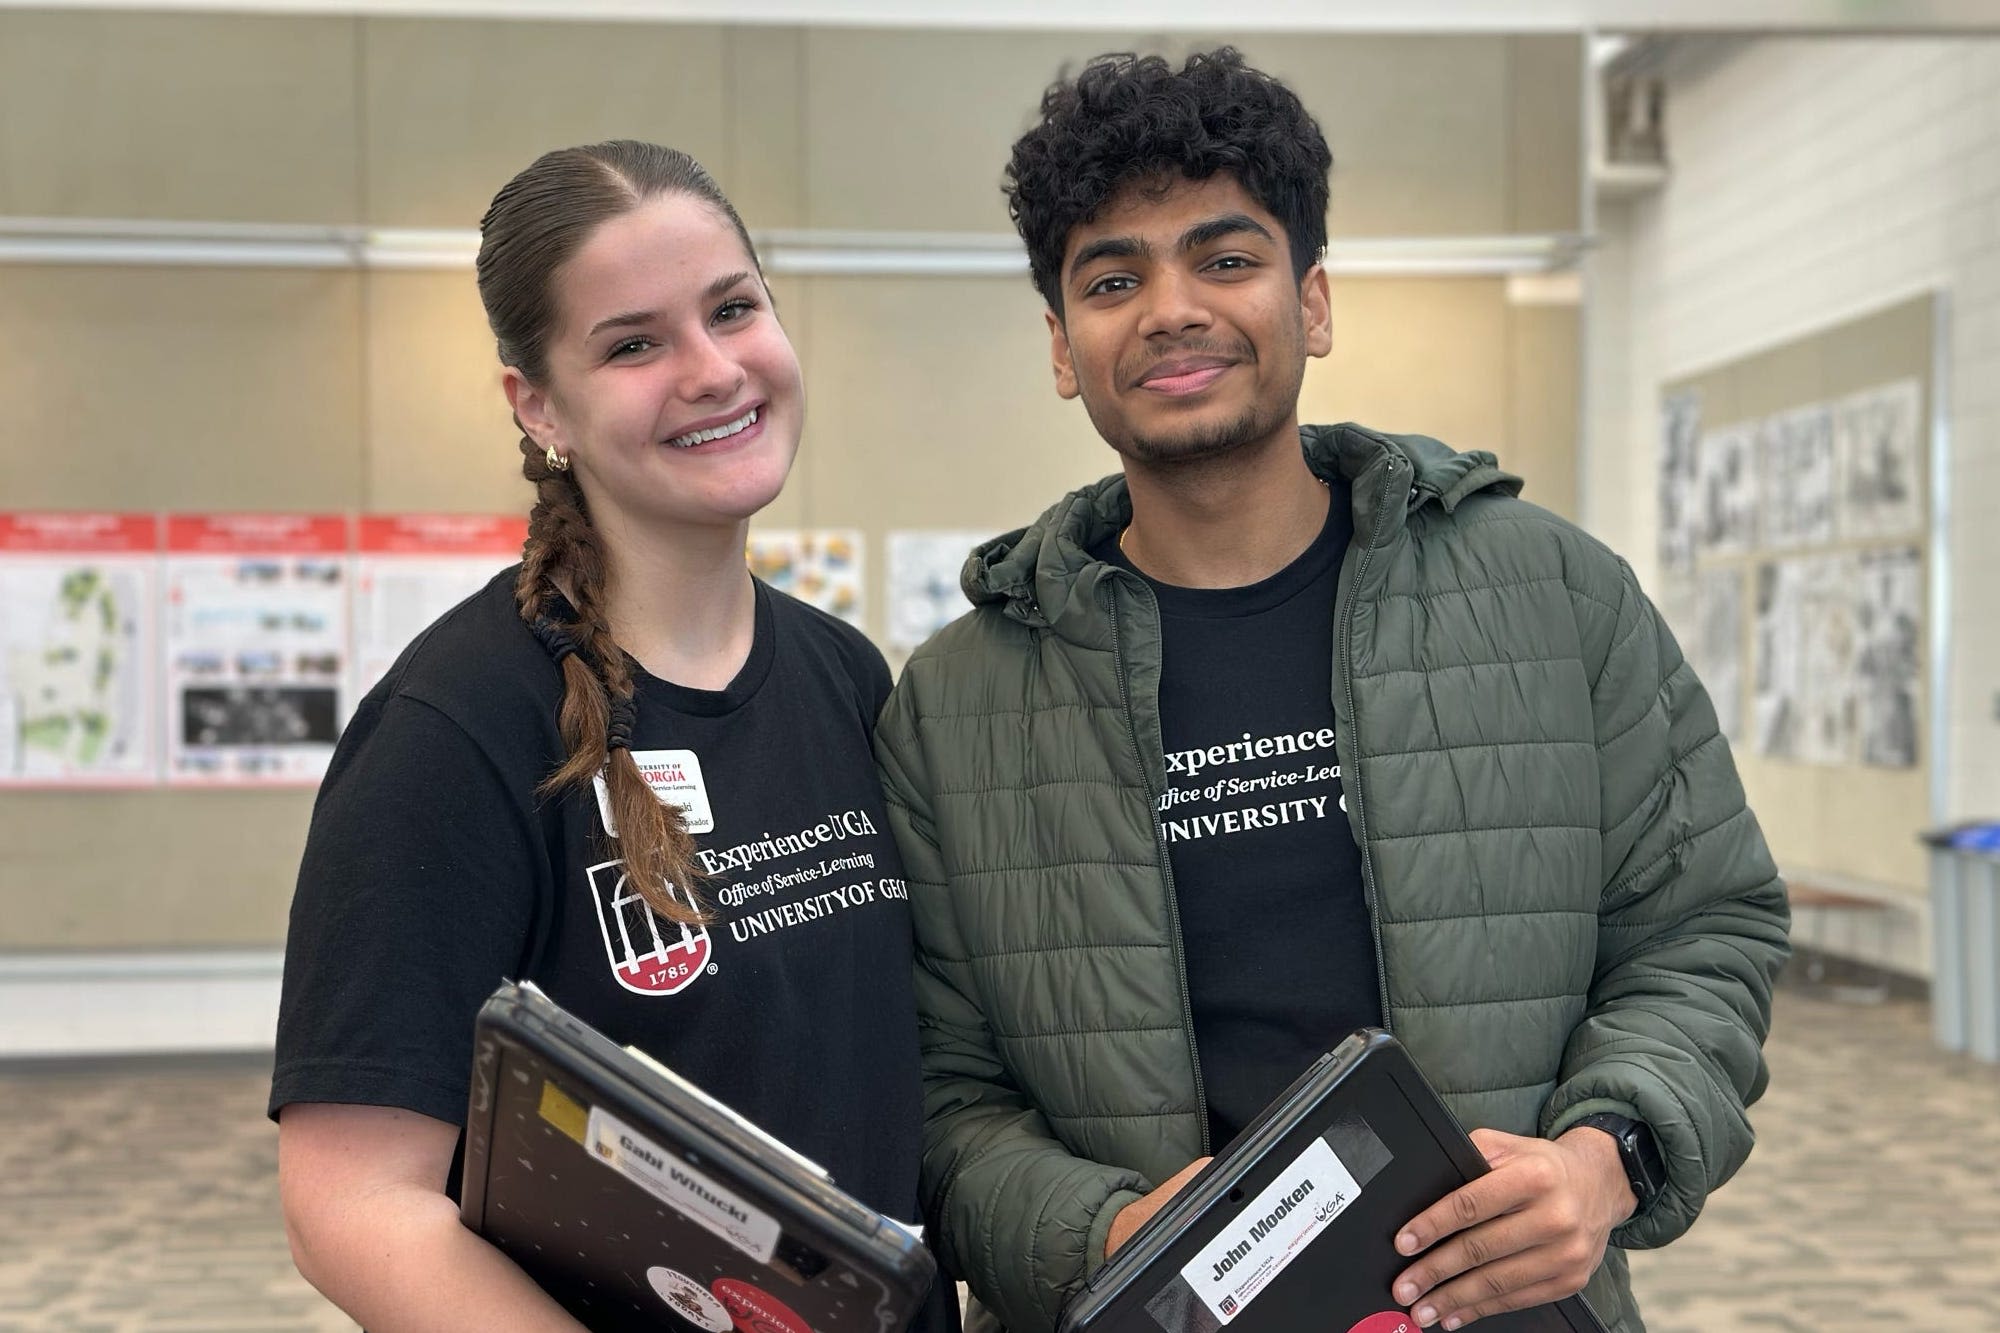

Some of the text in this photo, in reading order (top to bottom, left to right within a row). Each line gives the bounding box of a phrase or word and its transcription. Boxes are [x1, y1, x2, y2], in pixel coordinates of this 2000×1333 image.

[1164, 728, 1336, 777] xperience
[1158, 765, 1342, 812] ffice of Service-Lea
[718, 881, 762, 907] Office
[761, 873, 775, 896] of
[649, 962, 689, 986] 1785
[619, 1134, 664, 1171] Gabi
[1212, 1239, 1252, 1282] John
[1249, 1178, 1315, 1243] Mooken
[721, 1285, 796, 1333] experien
